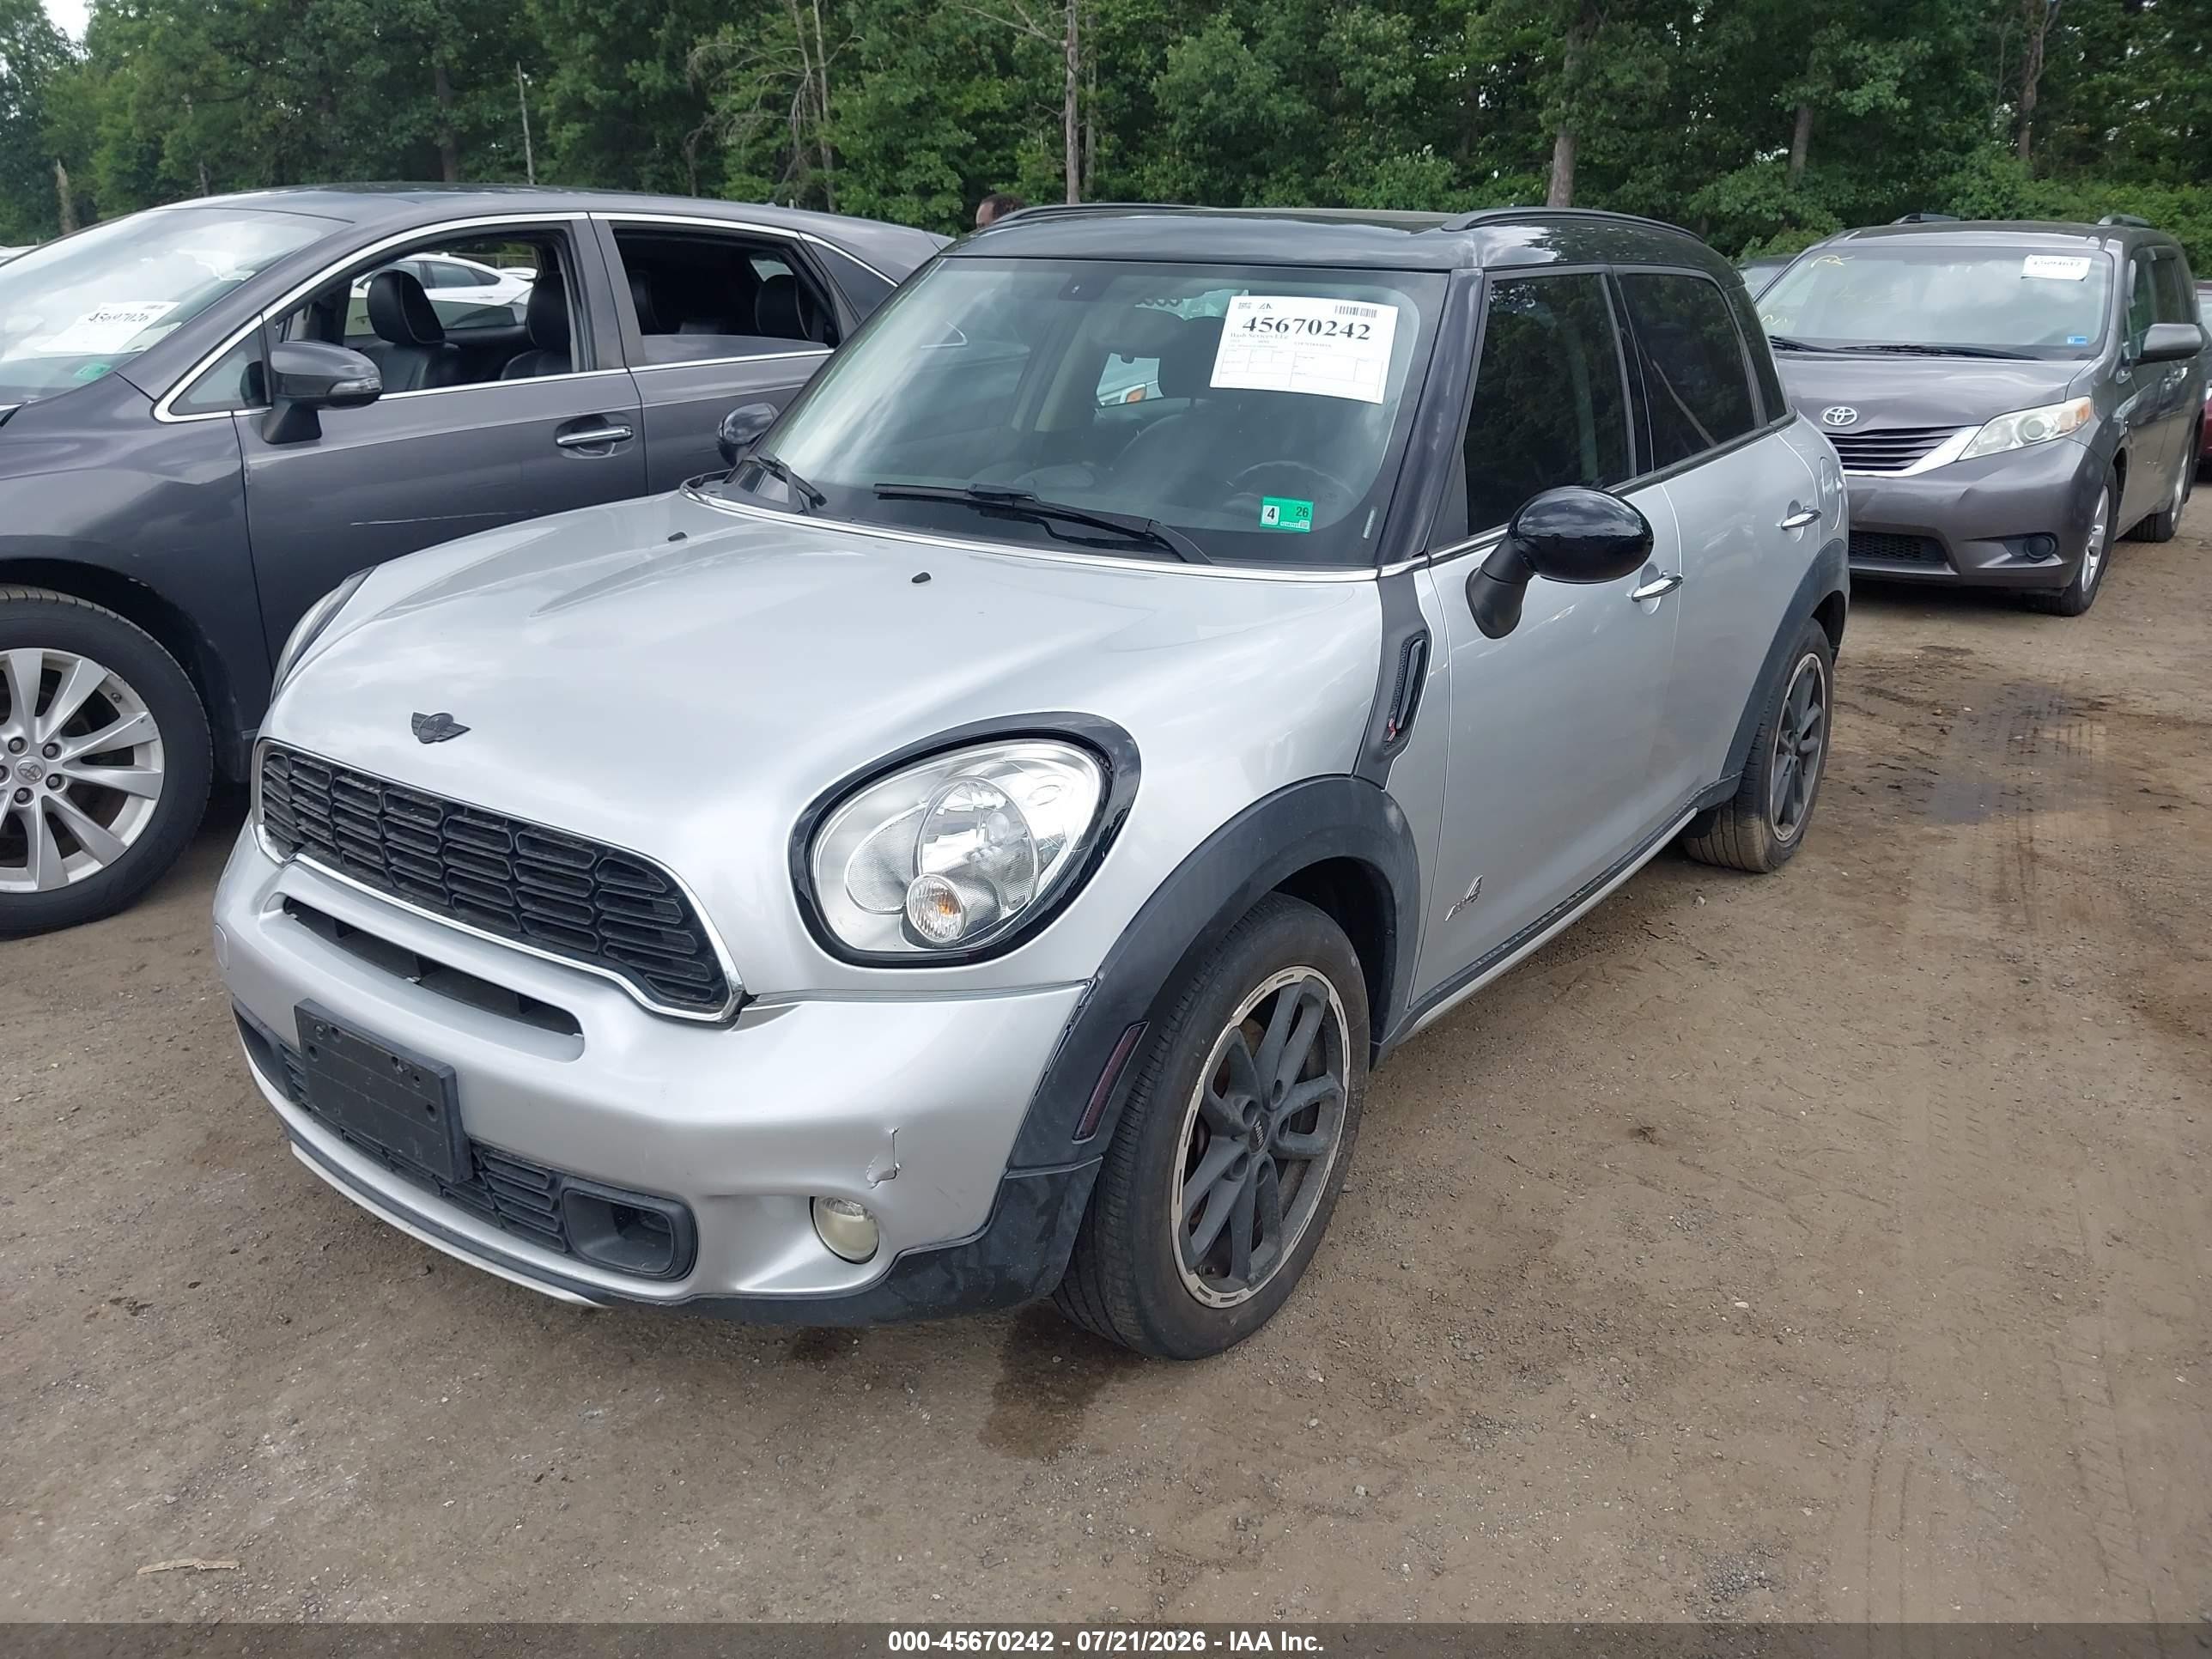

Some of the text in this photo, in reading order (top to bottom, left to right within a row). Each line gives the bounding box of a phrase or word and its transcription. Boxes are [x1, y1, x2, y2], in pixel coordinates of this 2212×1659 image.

[1242, 316, 1372, 341] 45670242
[1267, 506, 1310, 520] 4 26
[1253, 1119, 1266, 1148] MINI
